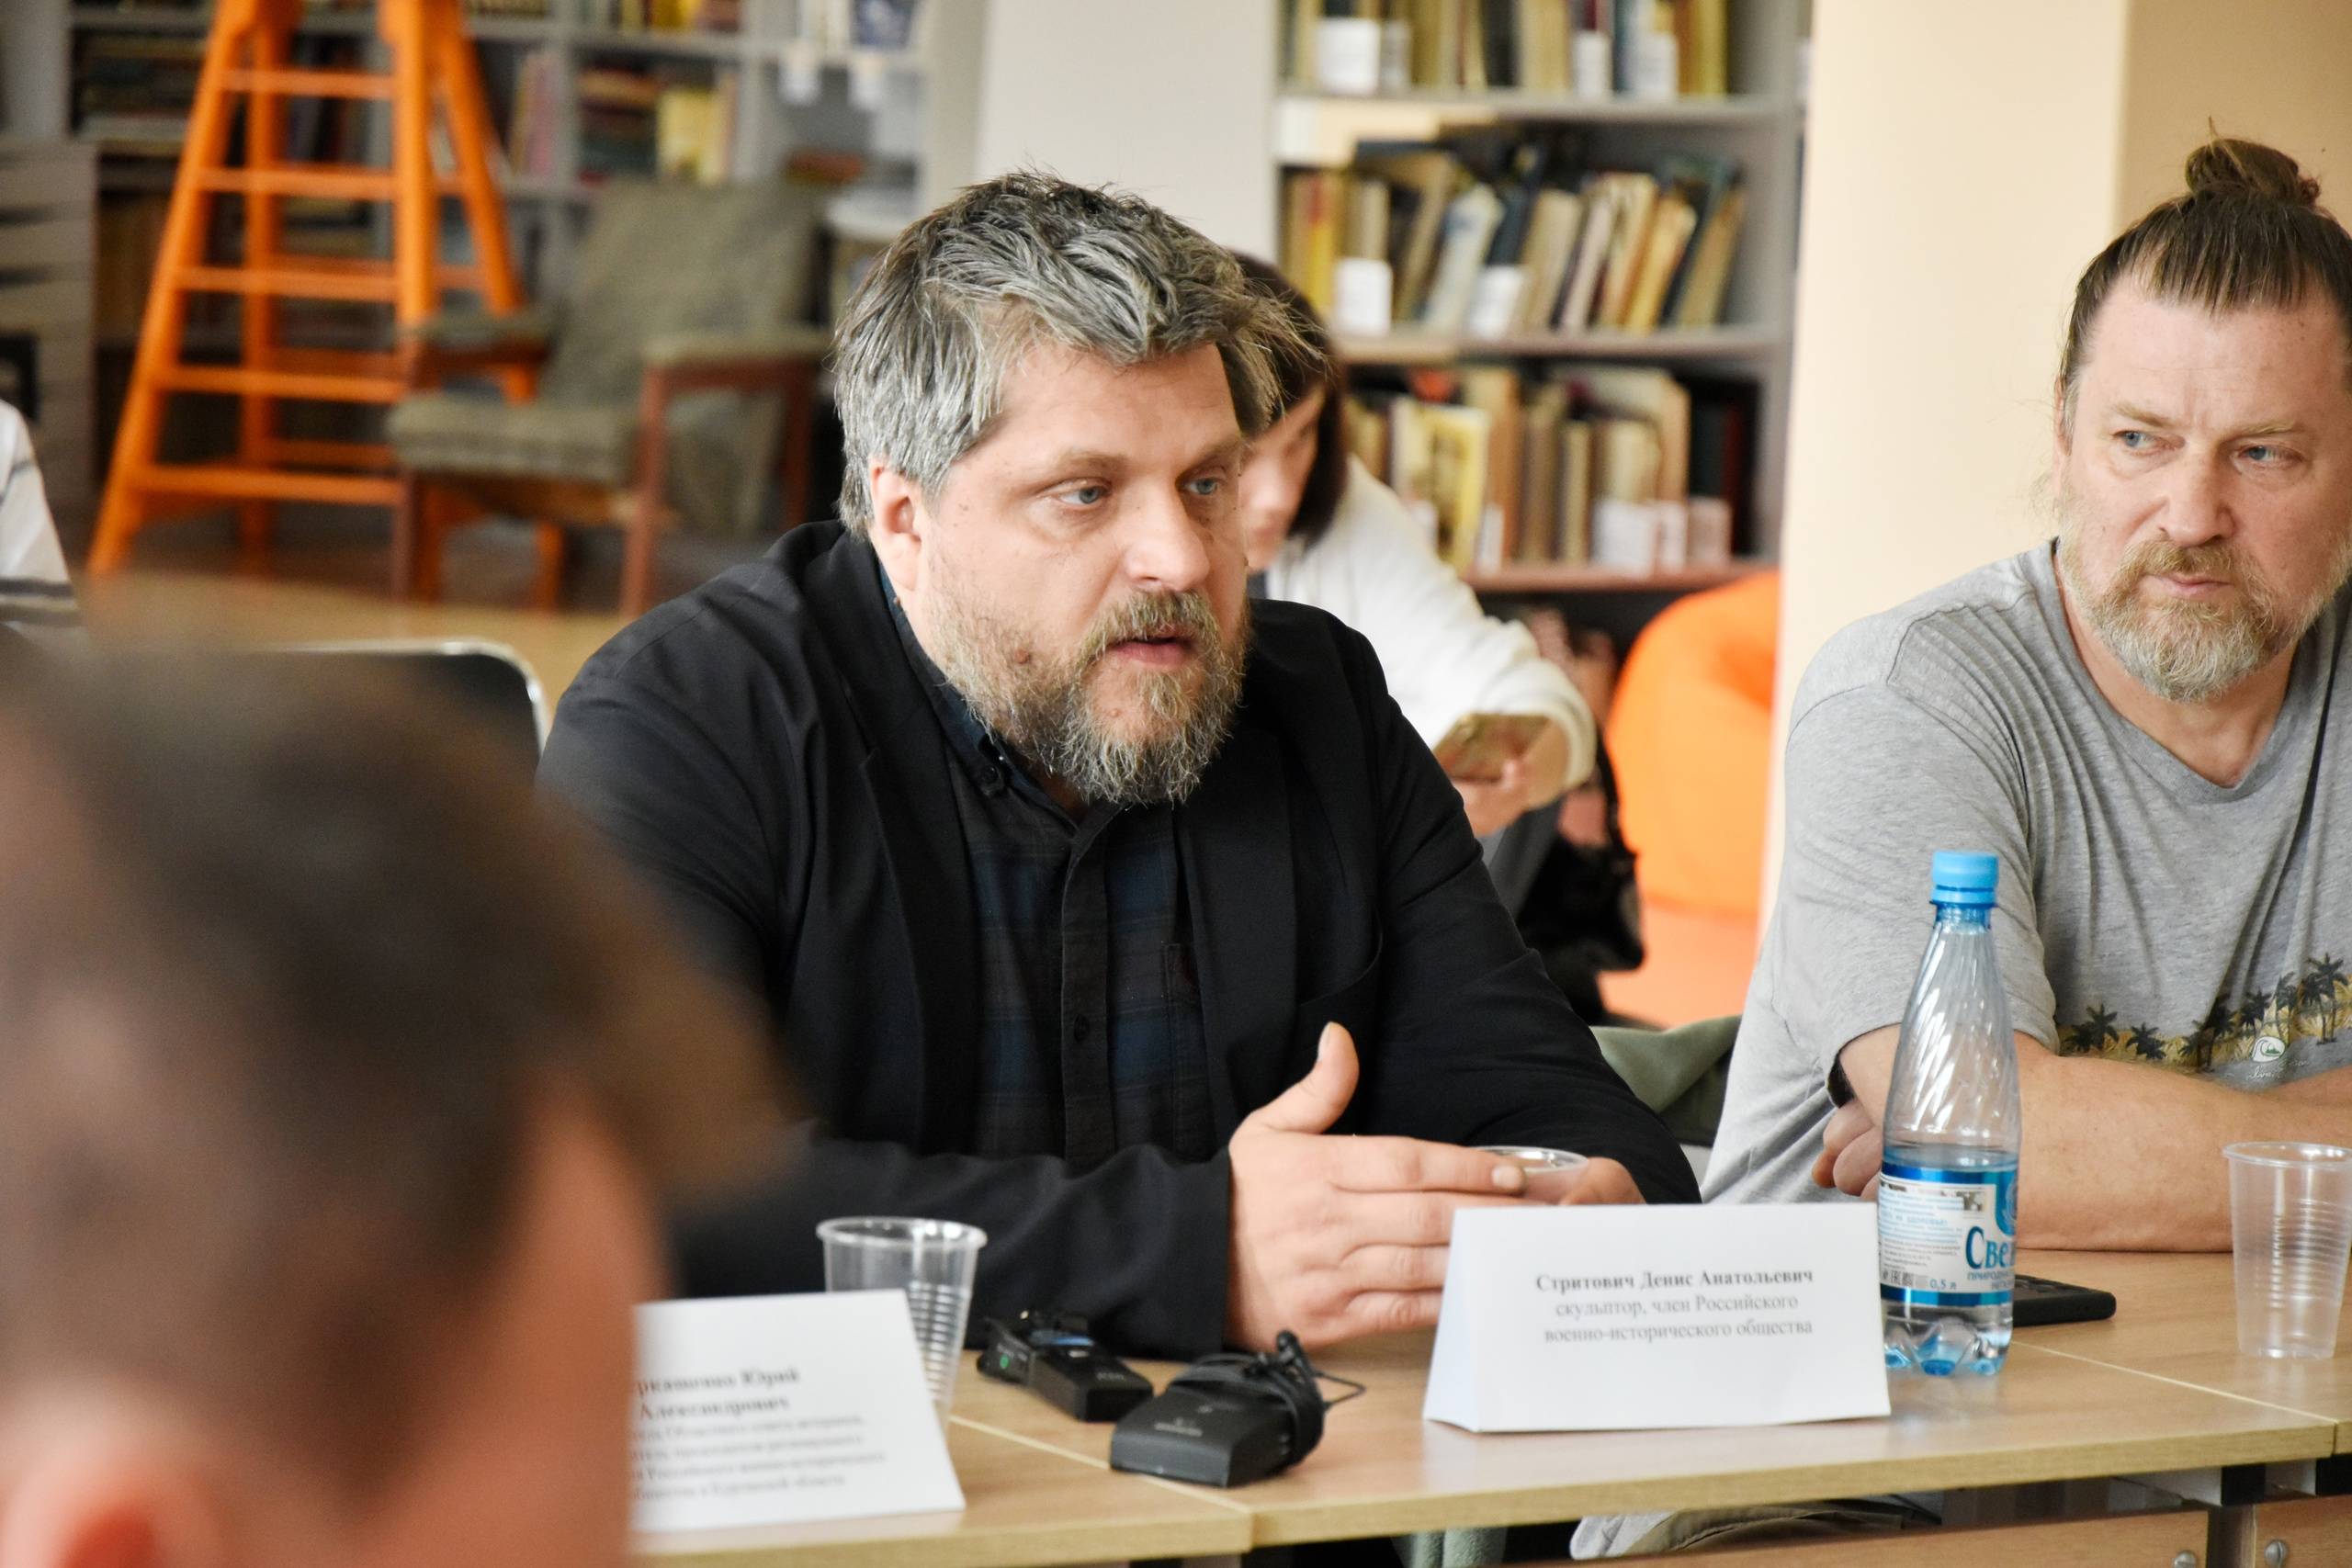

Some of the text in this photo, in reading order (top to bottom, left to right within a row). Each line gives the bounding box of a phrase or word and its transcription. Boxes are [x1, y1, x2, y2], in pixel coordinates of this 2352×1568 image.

[1535, 1269, 1815, 1295] Стритович Денис Анатольевич
[1554, 1293, 1800, 1321] скульптор, член Российского
[1544, 1317, 1814, 1344] военно-исторического общества
